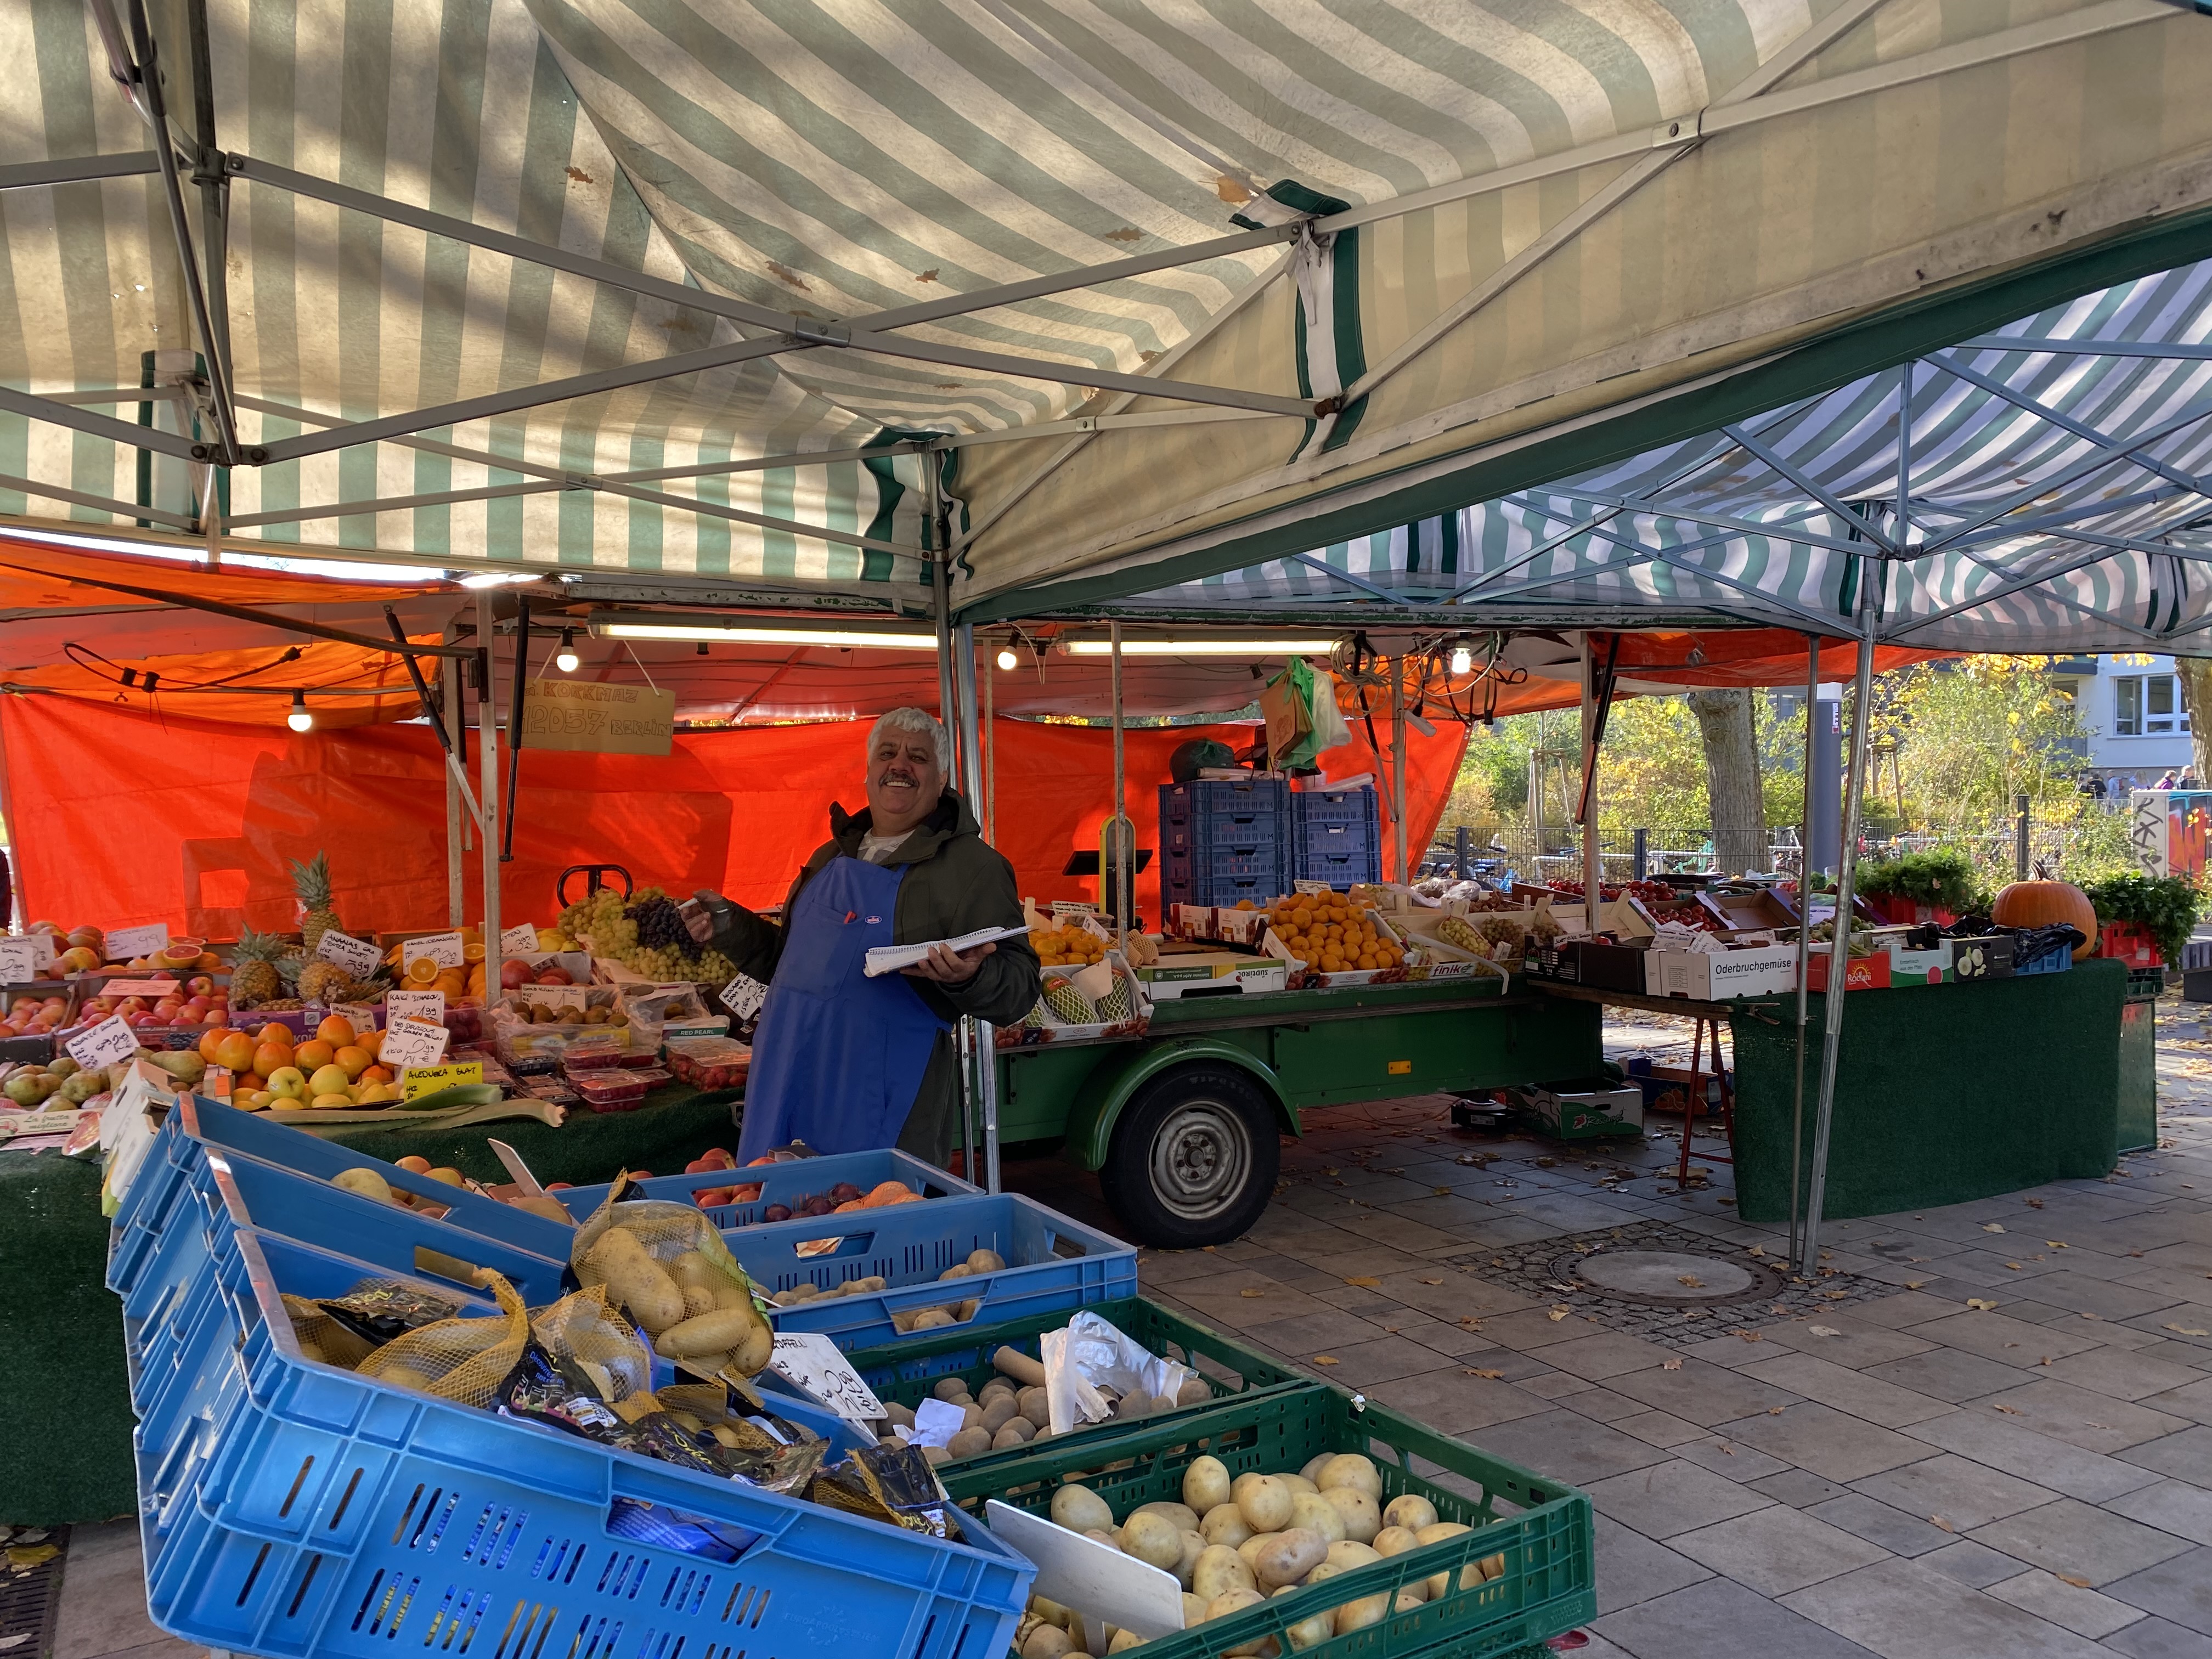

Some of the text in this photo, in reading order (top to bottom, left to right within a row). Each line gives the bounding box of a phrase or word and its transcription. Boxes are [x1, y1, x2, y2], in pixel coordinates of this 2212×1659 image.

[544, 682, 639, 703] KORKMAZ
[326, 934, 357, 949] ANANAS
[1716, 958, 1791, 975] Oderbruchgemüse
[24, 1114, 70, 1124] La frutta
